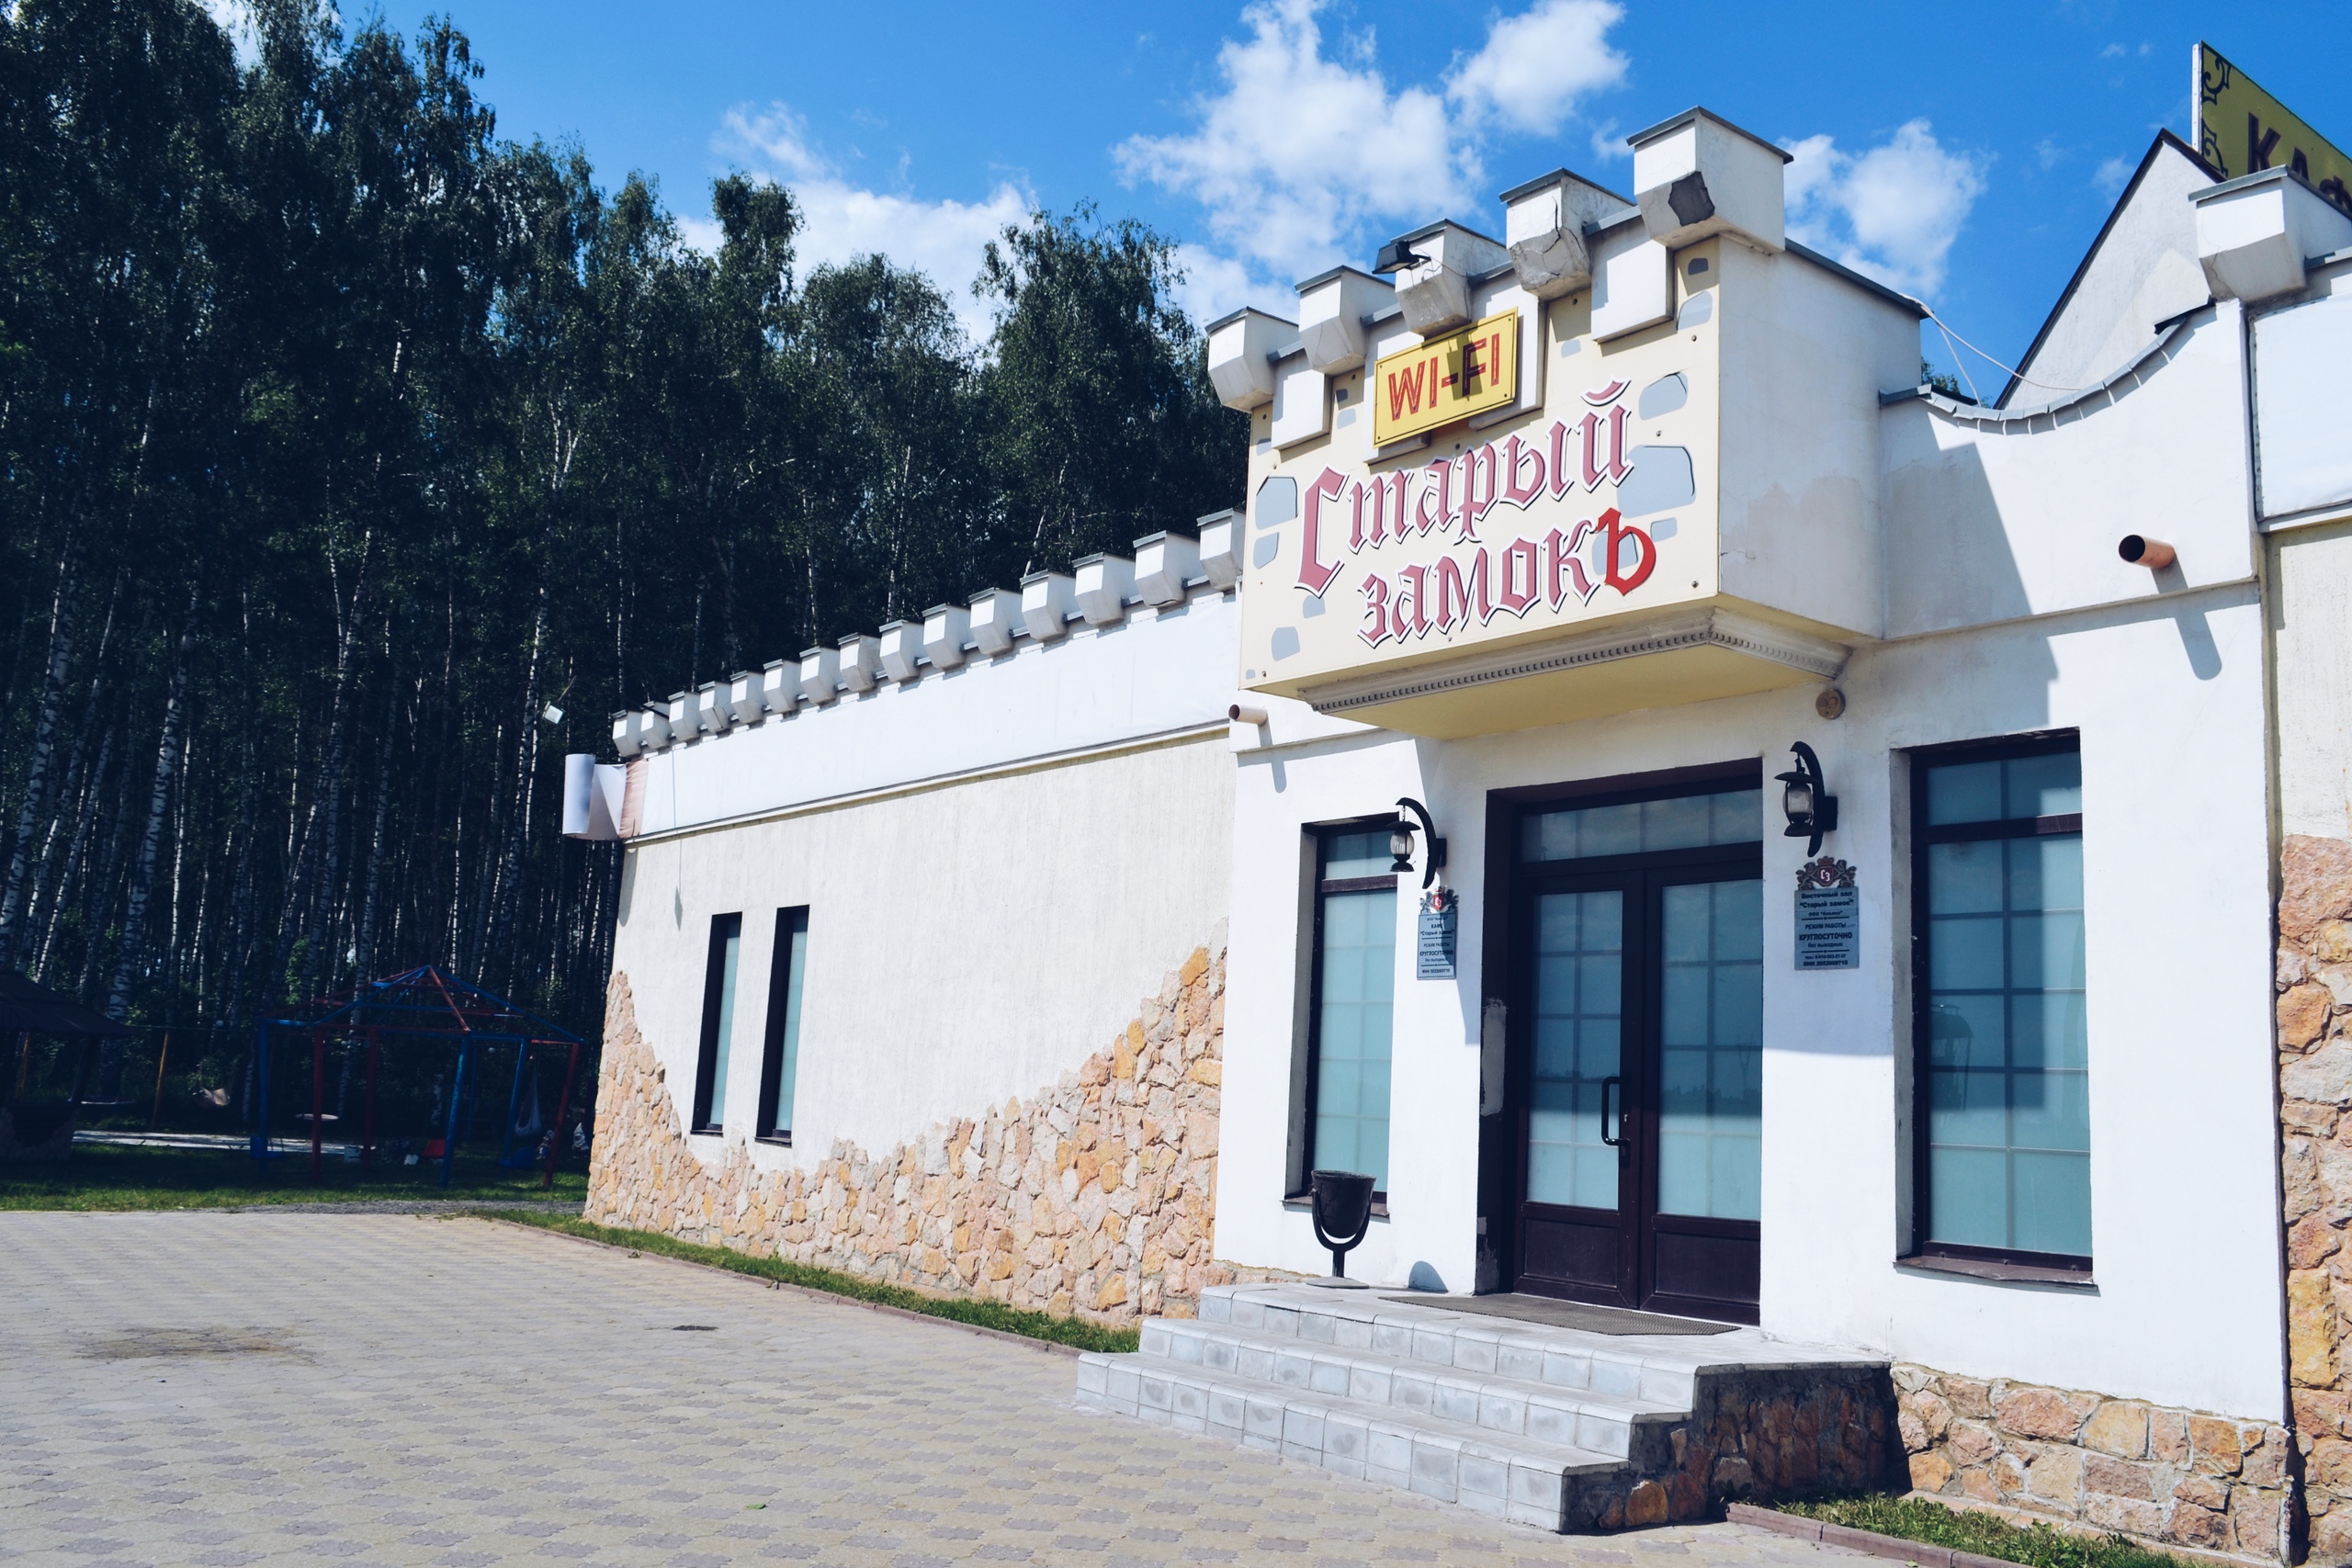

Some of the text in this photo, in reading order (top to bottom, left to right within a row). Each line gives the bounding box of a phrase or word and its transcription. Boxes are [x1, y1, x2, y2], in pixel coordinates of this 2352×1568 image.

[1387, 332, 1500, 421] WI-FI
[1295, 379, 1635, 597] Старый
[1799, 932, 1852, 941] КРУГЛОСУТОЧНО
